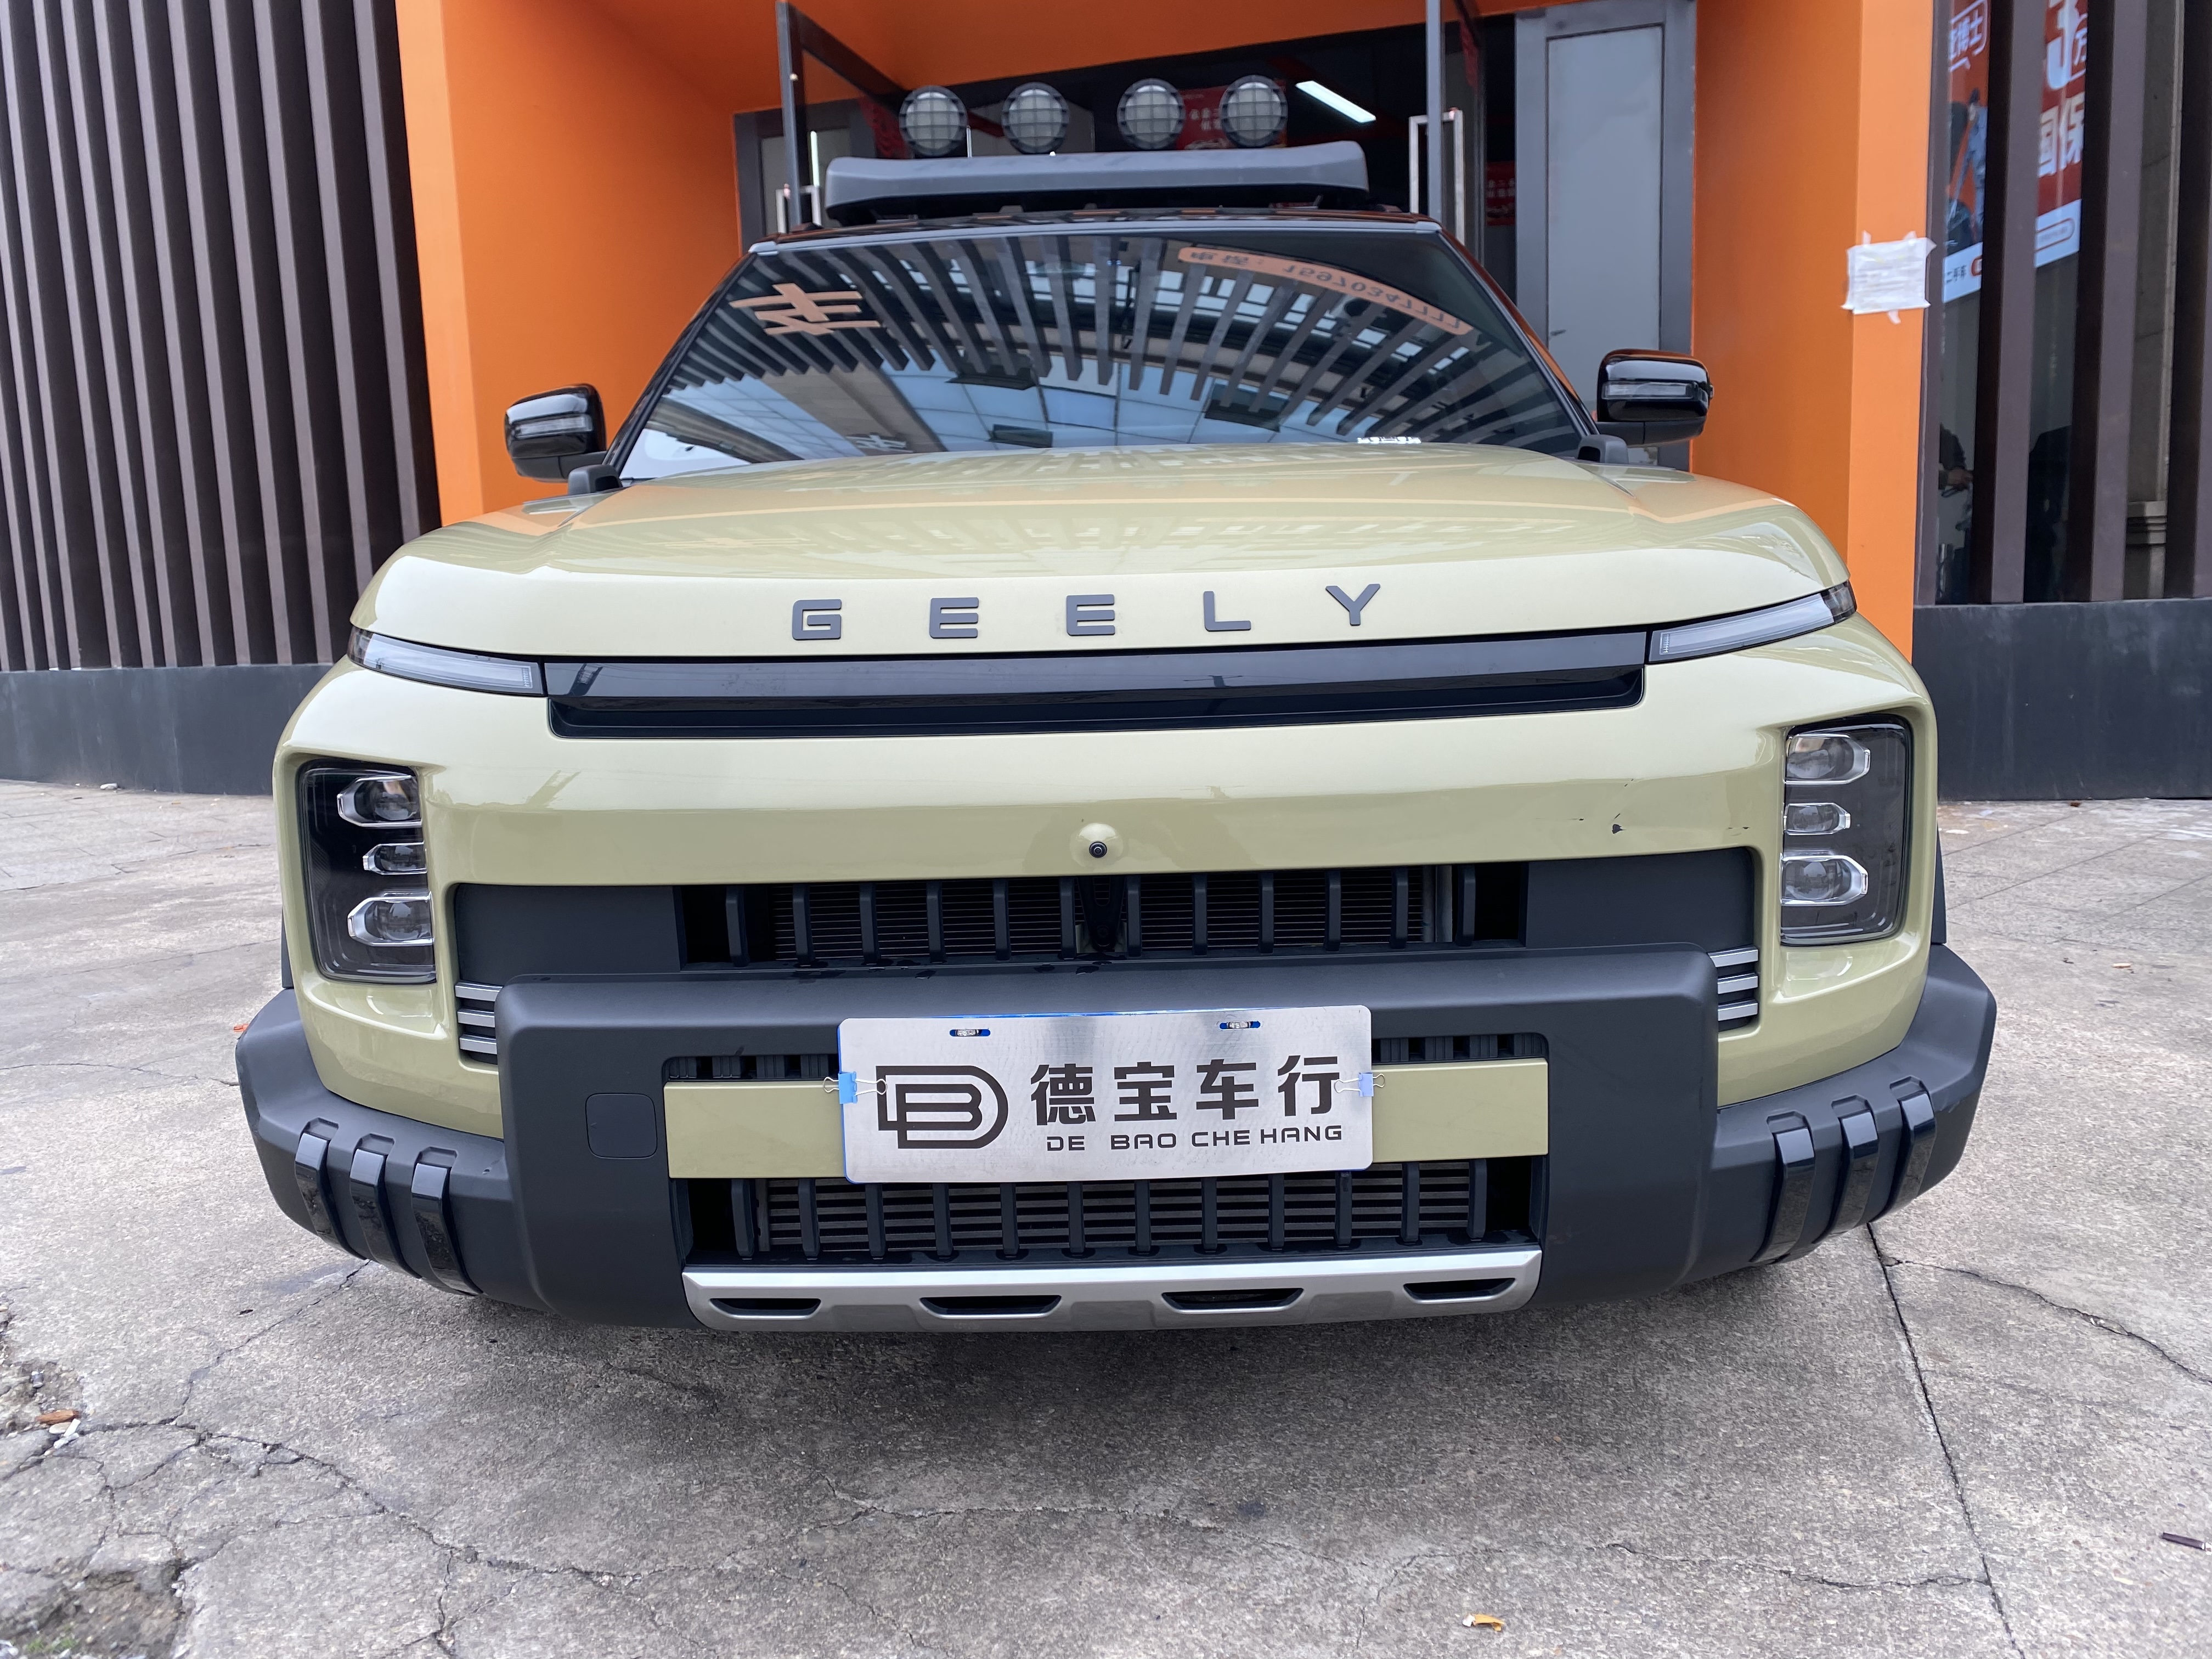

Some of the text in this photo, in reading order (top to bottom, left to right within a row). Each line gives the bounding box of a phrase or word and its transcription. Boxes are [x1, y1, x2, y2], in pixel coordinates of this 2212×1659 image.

[791, 583, 1381, 641] GEELY
[1030, 1055, 1340, 1126] 德宝车行
[1047, 1125, 1342, 1152] DE BAO CHE HANG
